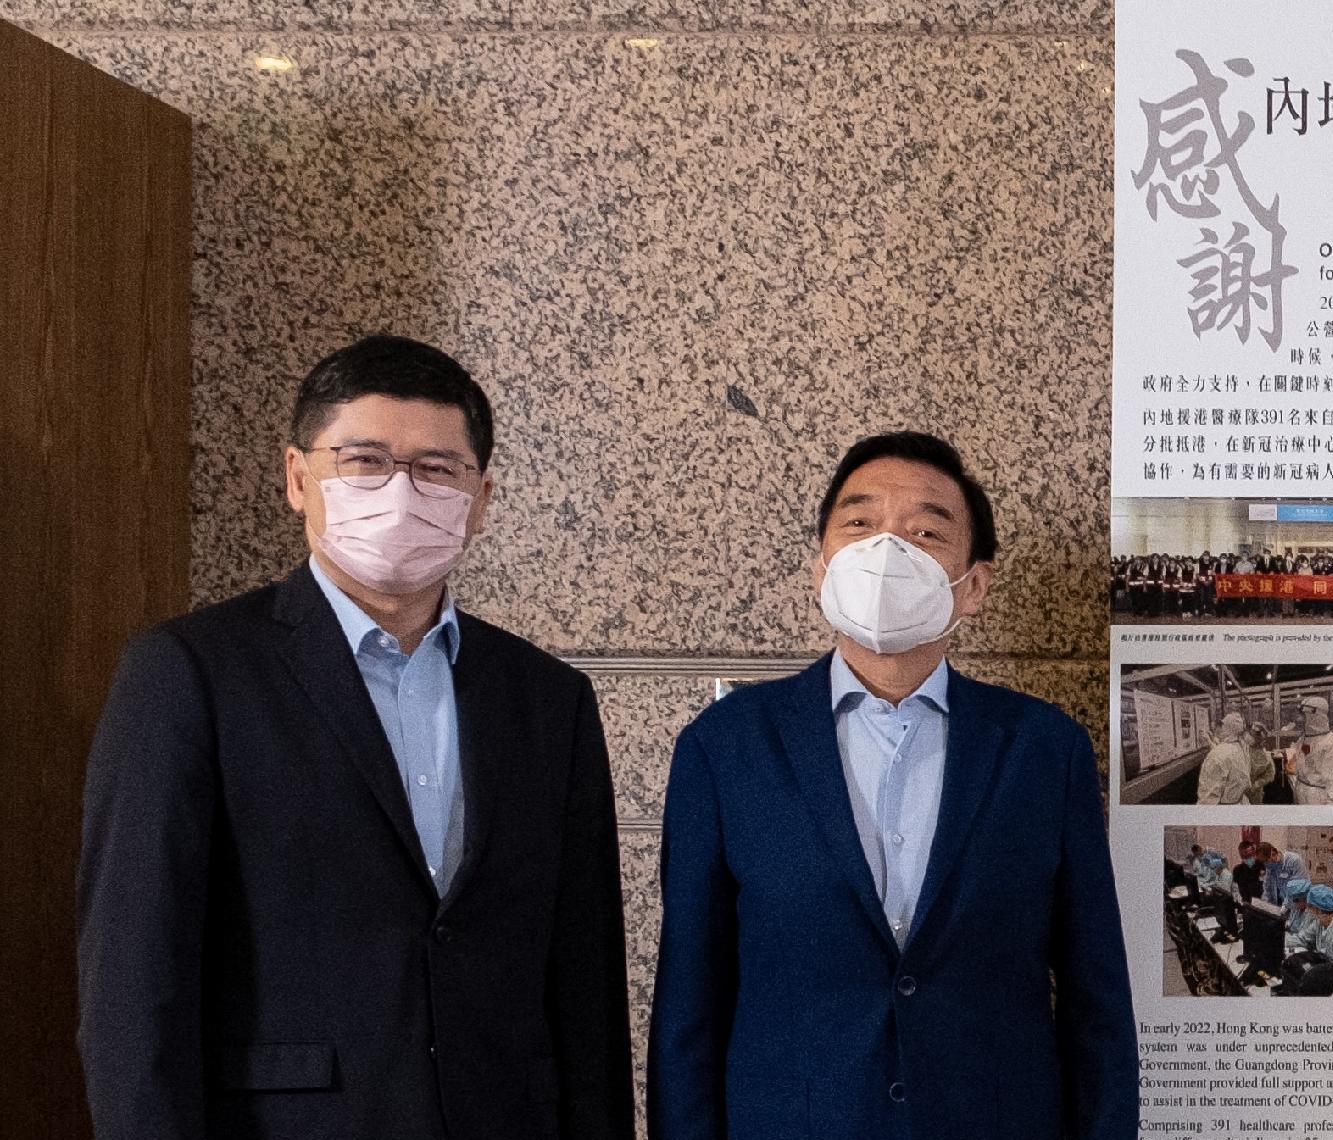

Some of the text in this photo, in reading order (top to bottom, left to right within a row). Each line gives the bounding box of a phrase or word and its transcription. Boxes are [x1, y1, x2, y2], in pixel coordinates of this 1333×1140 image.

[1184, 1022, 1215, 1037] 2022,
[1216, 1022, 1246, 1037] Hong
[1249, 1022, 1279, 1037] Kong
[1283, 1026, 1303, 1034] was
[1138, 1058, 1217, 1073] Government,
[1215, 1058, 1231, 1070] the
[1235, 1058, 1298, 1073] Guangdong
[1139, 1095, 1150, 1107] to
[1153, 1095, 1182, 1107] assist
[1186, 1095, 1196, 1107] in
[1200, 1095, 1216, 1107] the
[1220, 1095, 1271, 1107] treatment
[1274, 1095, 1289, 1107] of
[1138, 1119, 1202, 1134] Comprising
[1212, 1119, 1230, 1131] 391
[1240, 1119, 1295, 1131] healthcare
